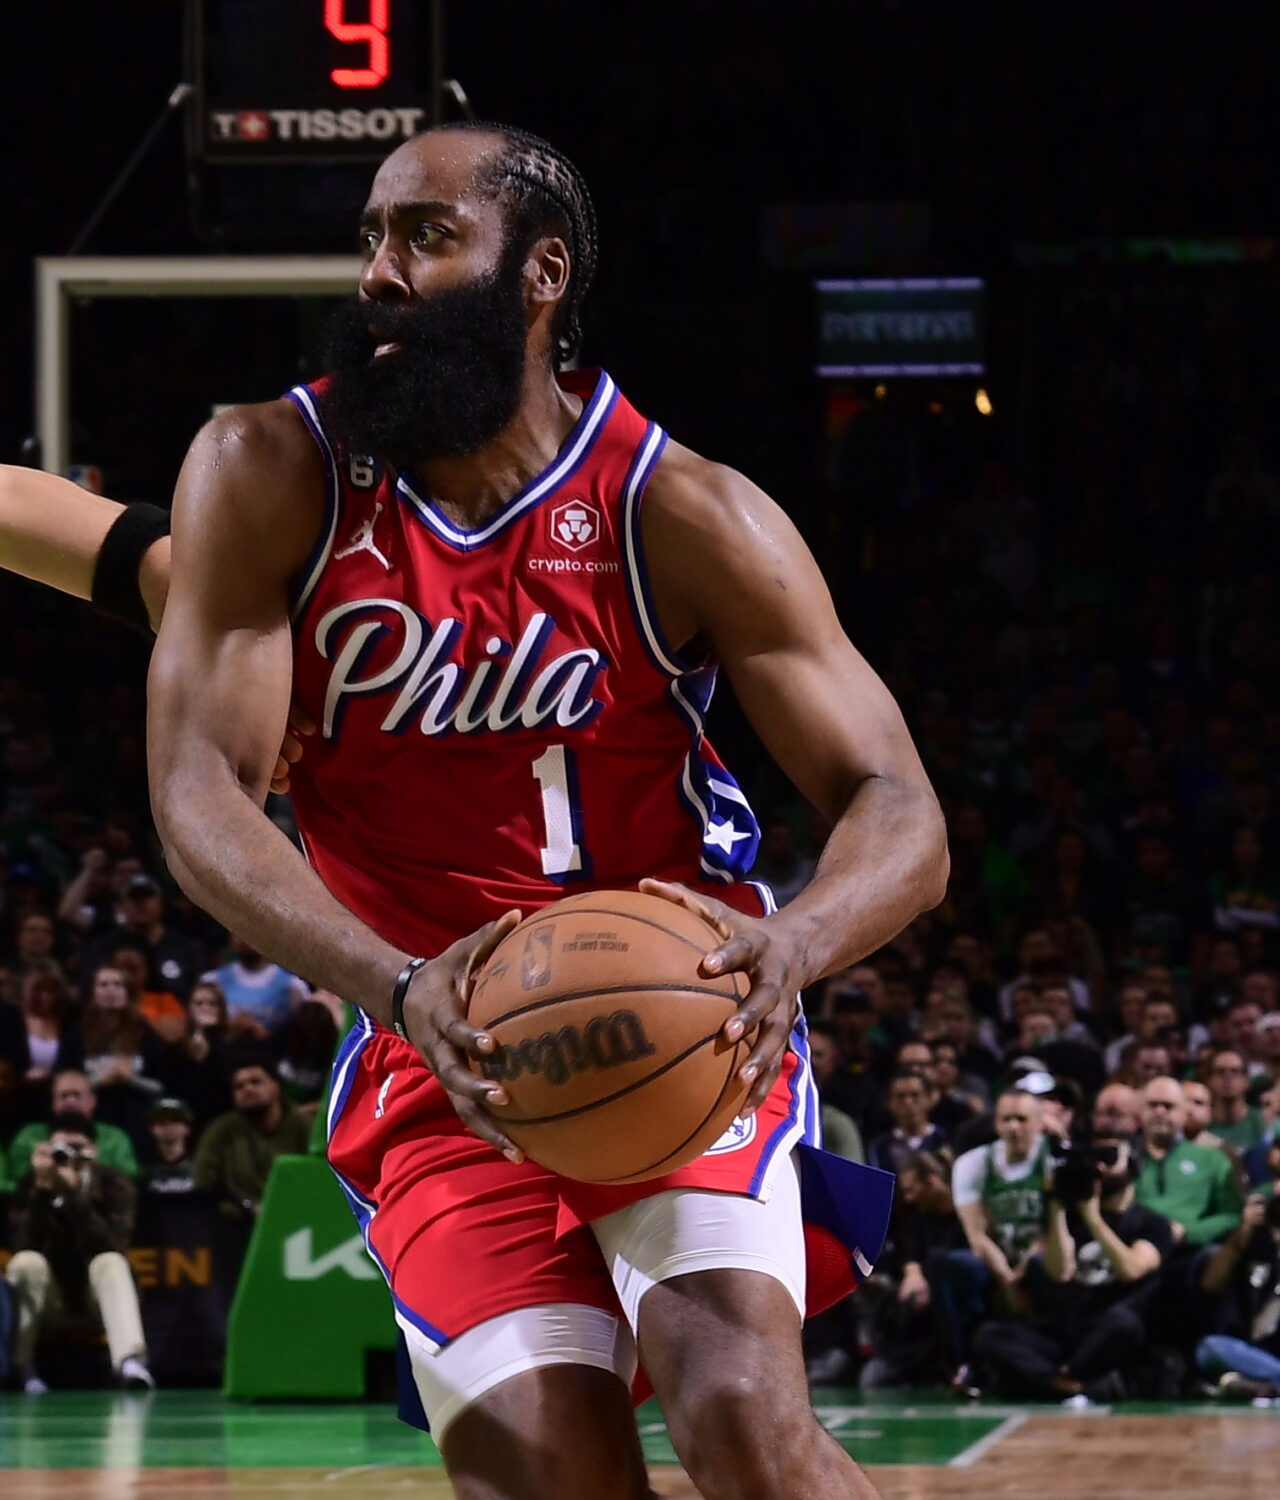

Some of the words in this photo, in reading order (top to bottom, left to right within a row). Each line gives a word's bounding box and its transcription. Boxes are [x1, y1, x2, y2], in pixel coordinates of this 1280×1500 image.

[270, 108, 423, 140] TISSOT
[349, 452, 374, 487] 6
[528, 557, 619, 573] crypto.com
[315, 598, 605, 739] Phila
[532, 744, 586, 878] 1
